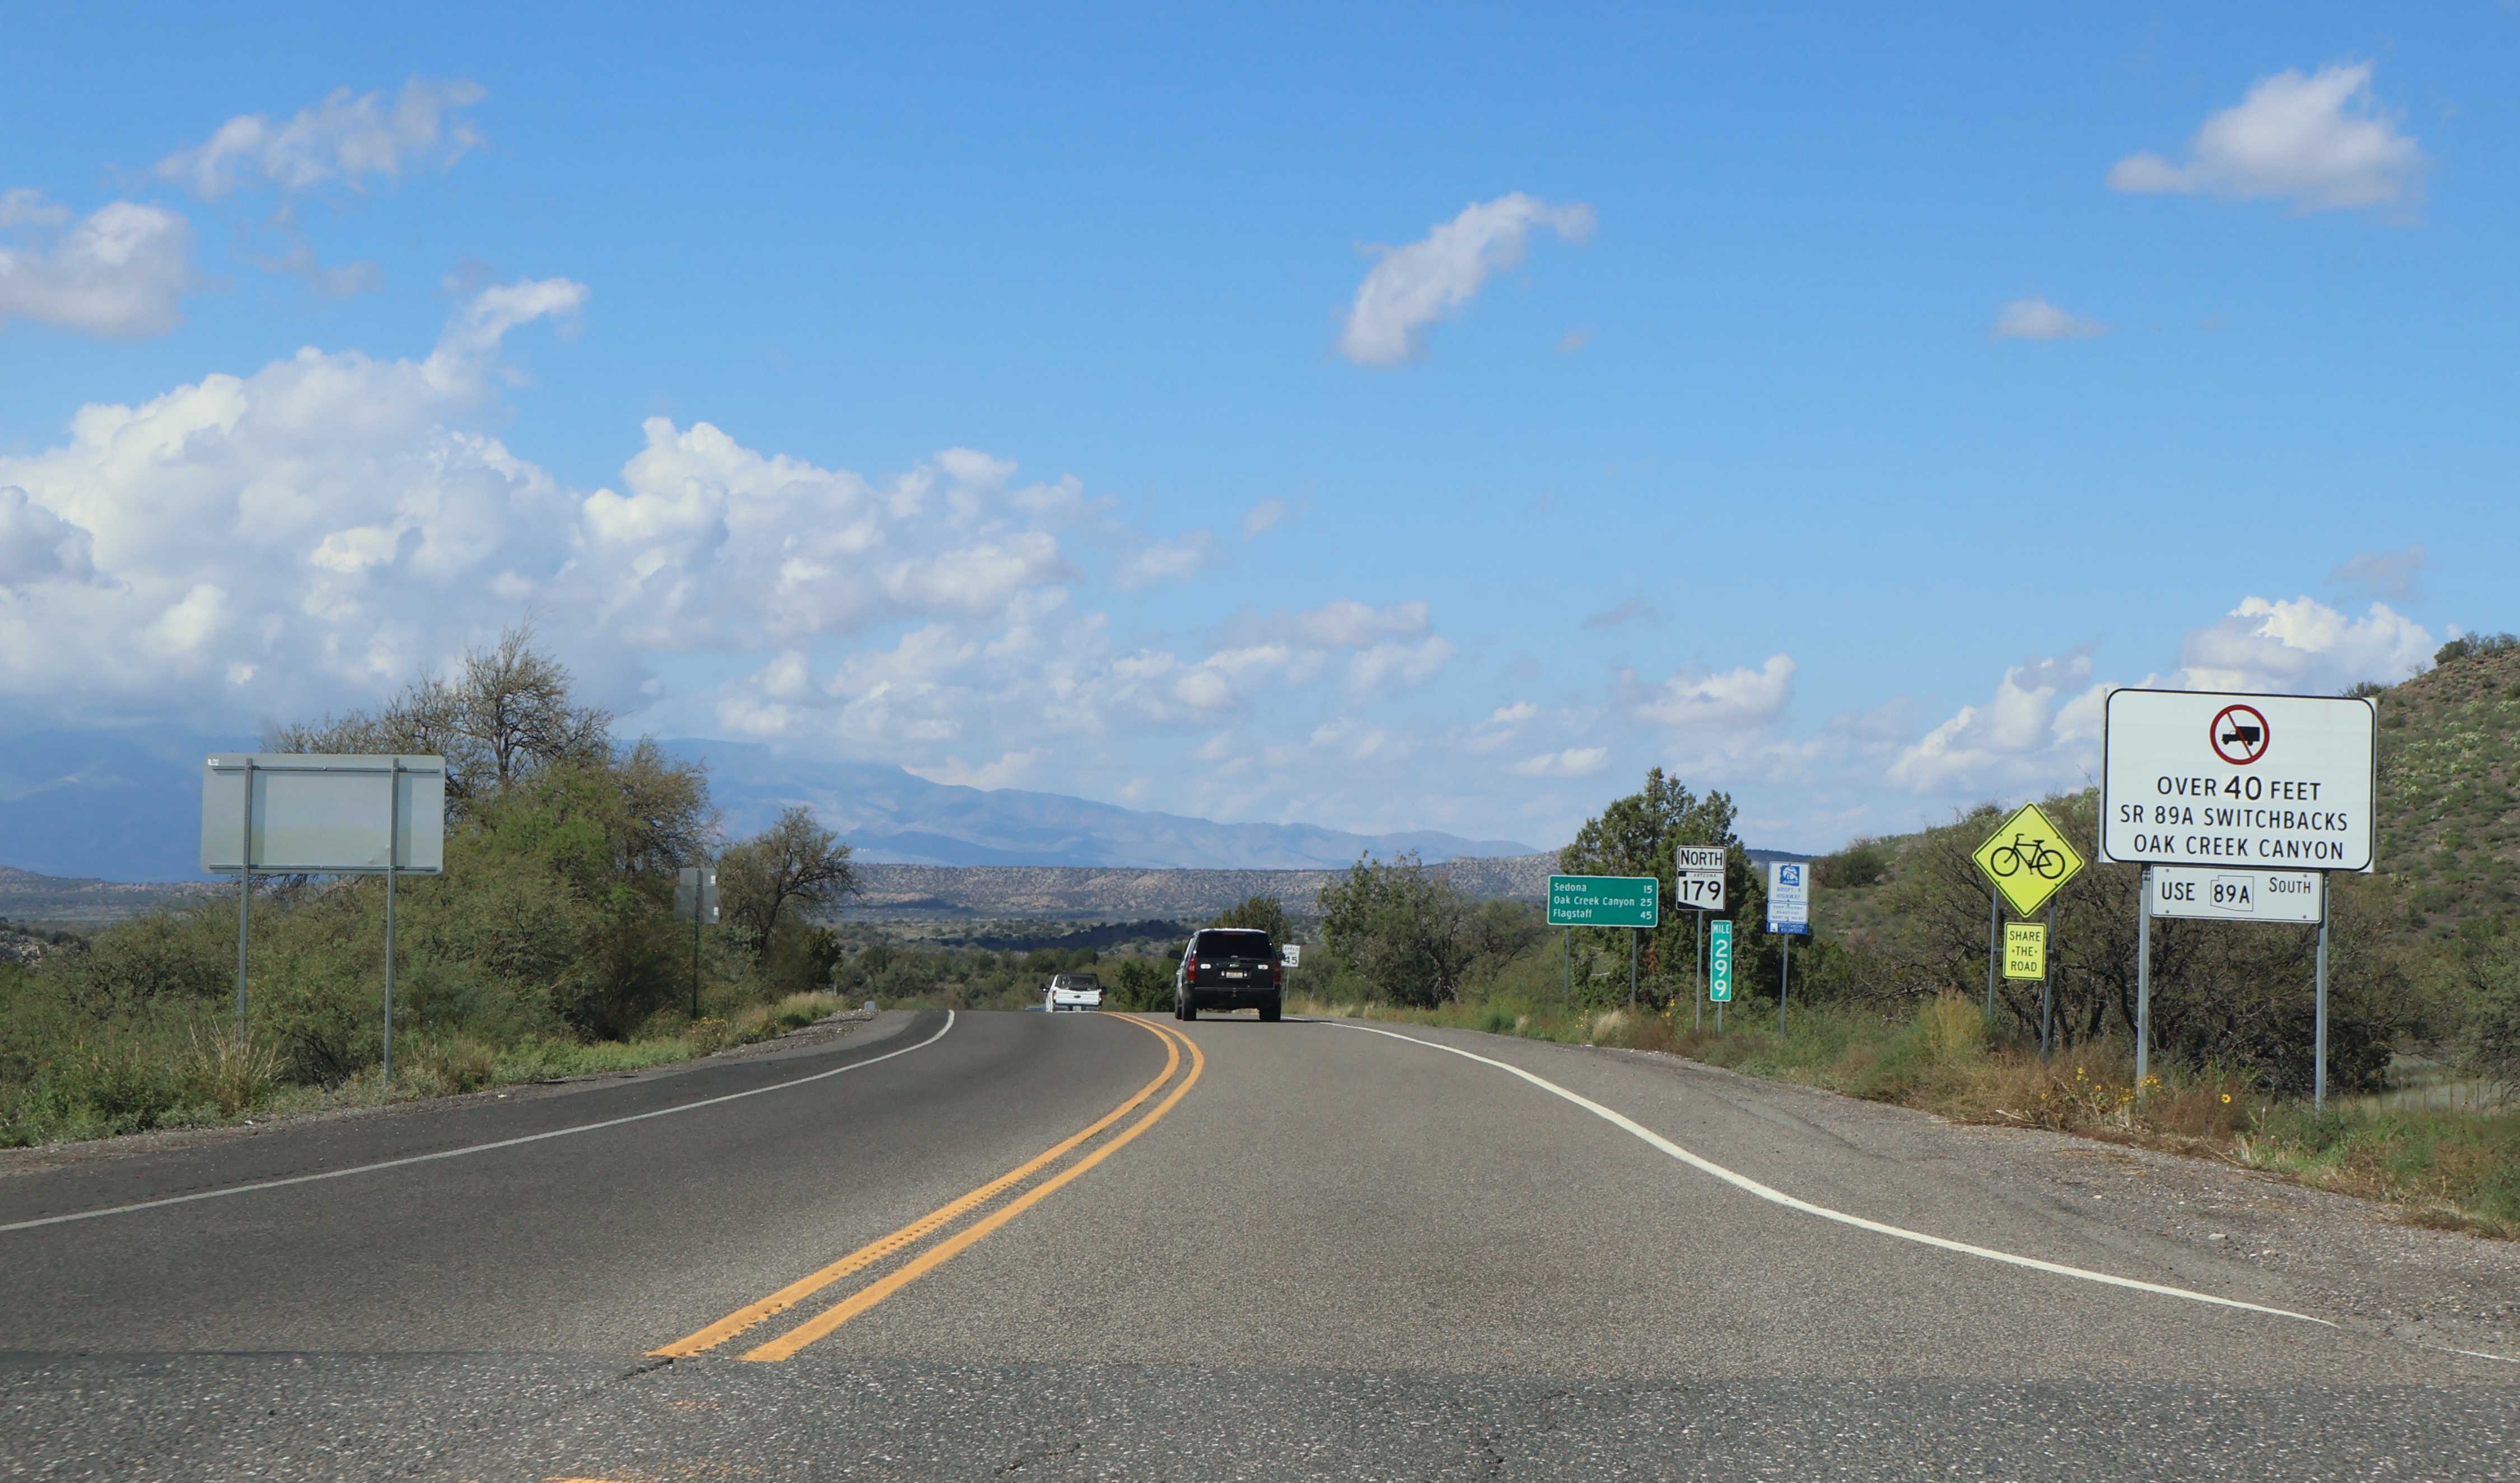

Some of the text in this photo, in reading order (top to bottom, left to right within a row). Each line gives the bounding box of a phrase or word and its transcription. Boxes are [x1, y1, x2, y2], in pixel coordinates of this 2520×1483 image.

[2157, 775, 2321, 801] OVER 40 FEET
[2120, 804, 2348, 831] SR 89A SWITCHBACKS
[2134, 834, 2343, 860] OAK CREEK CANYON
[1681, 850, 1723, 866] NORTH
[1554, 883, 1653, 893] Sedona 15
[1683, 879, 1721, 901] 179
[2162, 877, 2311, 904] USE 89A SOUTH
[1554, 896, 1652, 907] Oak Creek Canyon 25
[1553, 909, 1652, 920] Flagstaff 45
[1713, 924, 1730, 934] MILE
[2009, 930, 2041, 942] SHARE
[2011, 961, 2037, 972] ROAD
